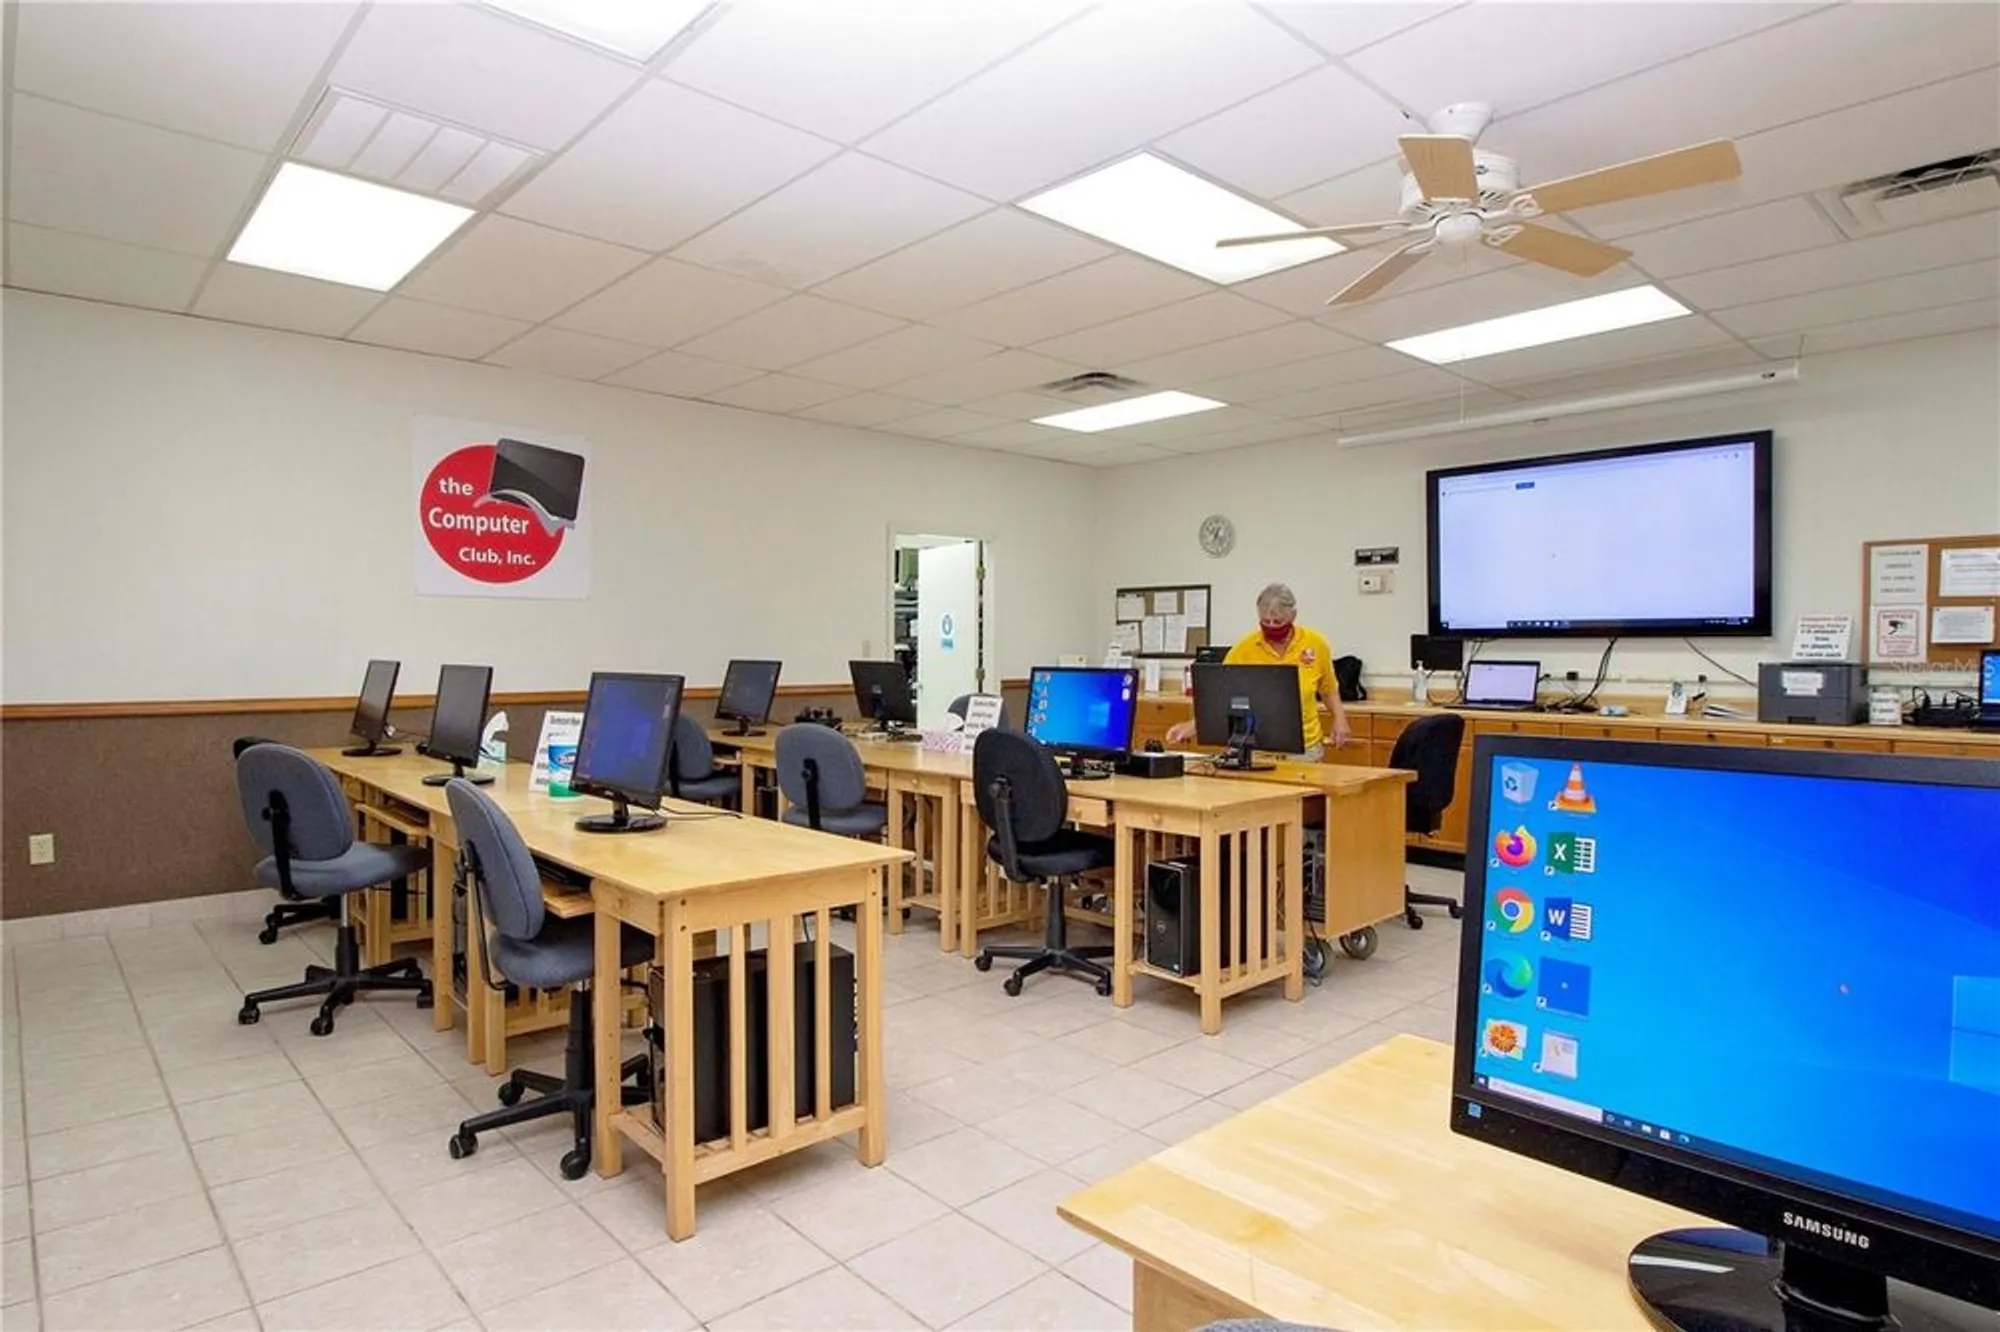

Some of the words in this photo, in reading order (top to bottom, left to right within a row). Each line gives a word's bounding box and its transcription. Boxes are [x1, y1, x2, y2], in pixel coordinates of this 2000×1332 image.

[439, 478, 473, 495] the
[428, 507, 529, 536] Computer
[459, 548, 502, 564] Club,
[507, 551, 536, 565] Inc.
[1553, 843, 1567, 861] X
[1547, 908, 1566, 926] W
[1783, 1211, 1870, 1249] SAMSUNG
